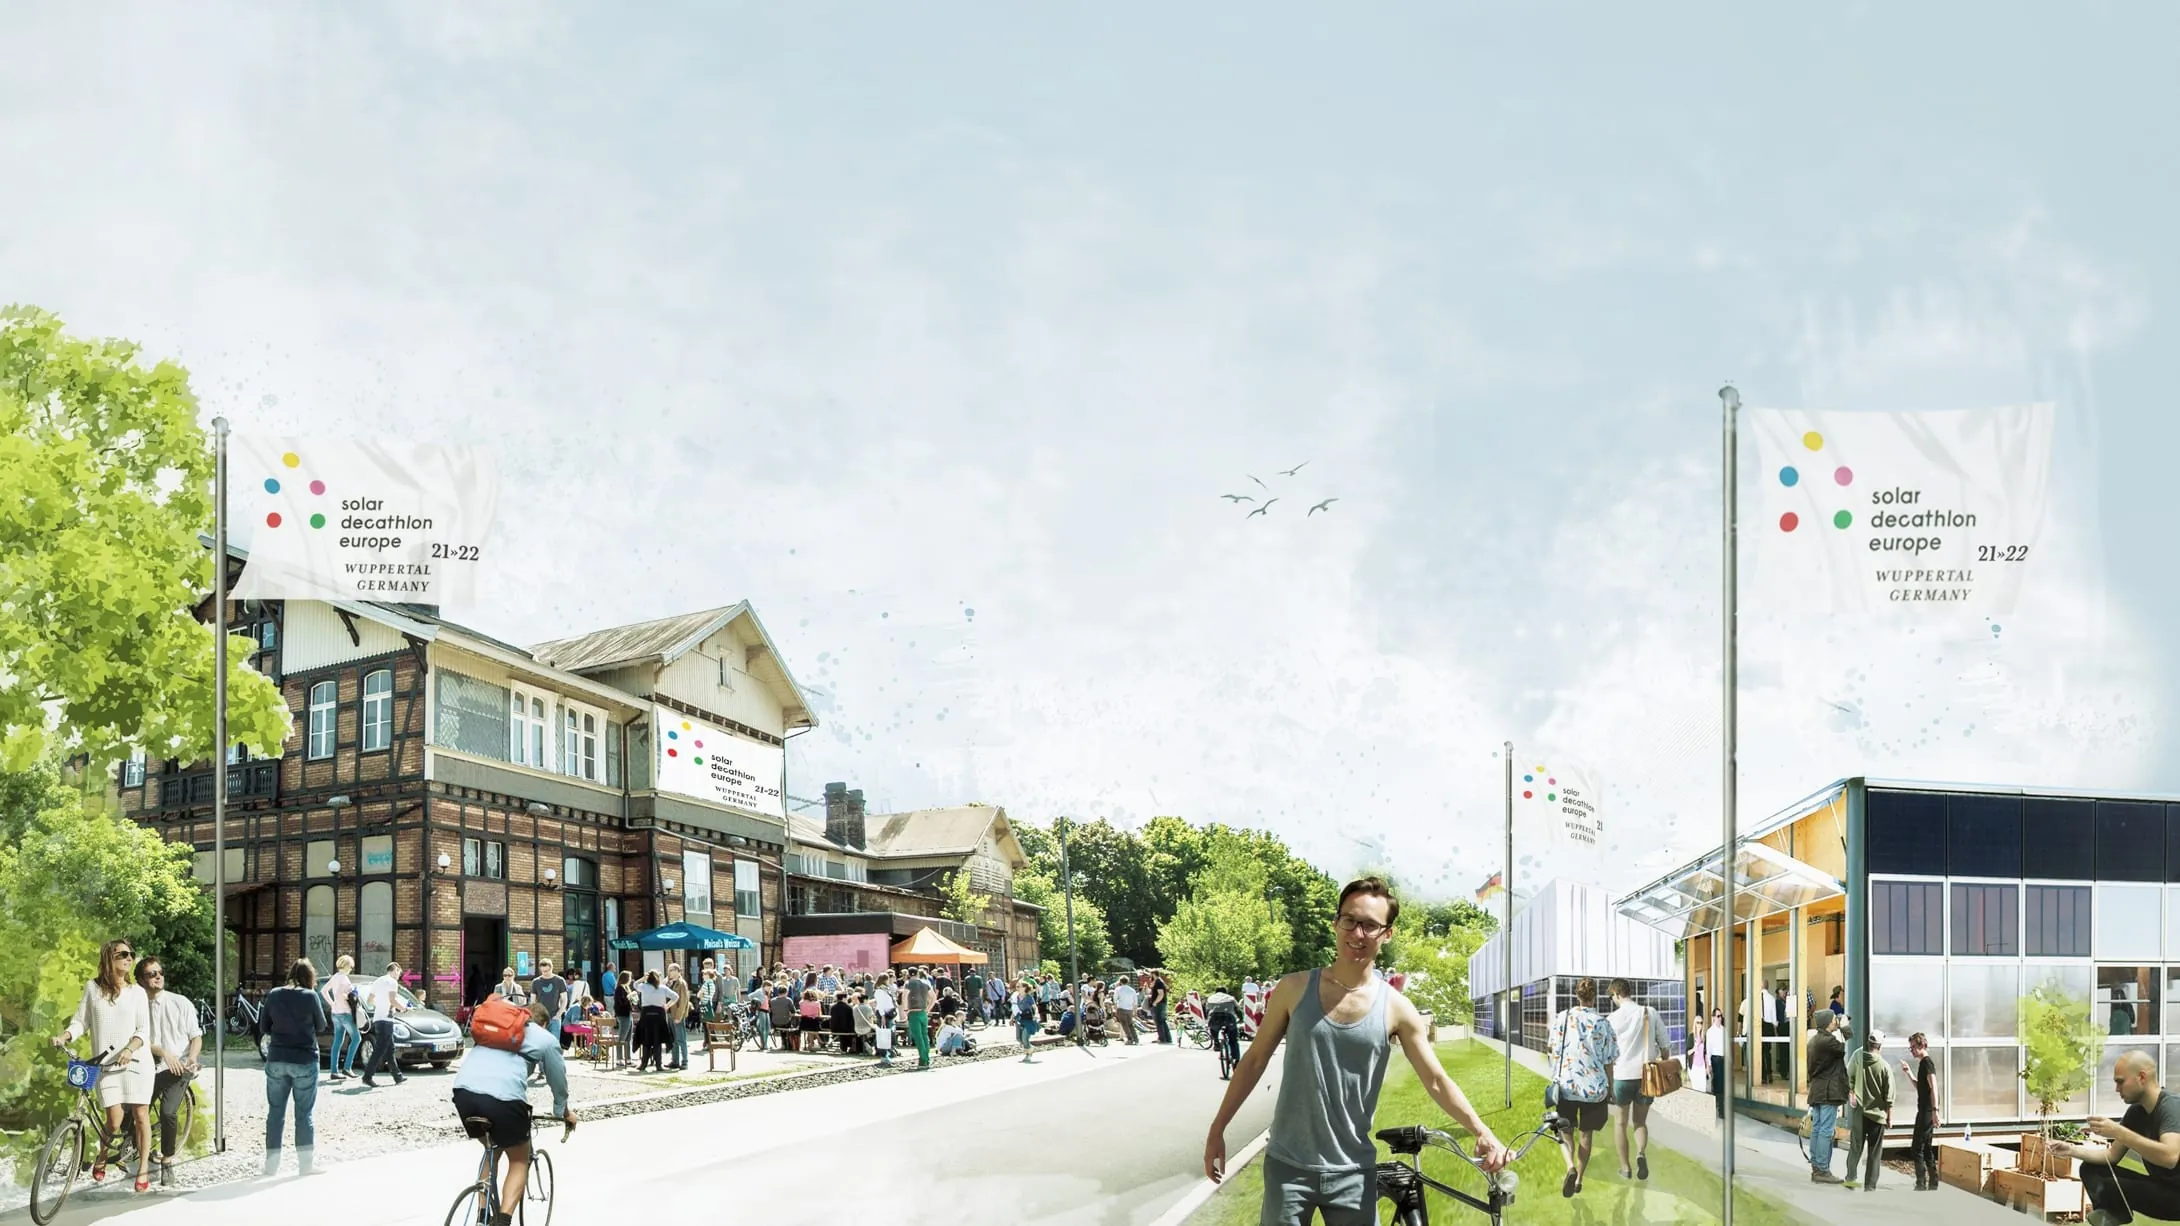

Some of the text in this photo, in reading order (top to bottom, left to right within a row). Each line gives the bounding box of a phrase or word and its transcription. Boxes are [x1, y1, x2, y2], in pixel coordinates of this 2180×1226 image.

[1871, 487, 1921, 504] solar
[341, 497, 384, 511] solar
[341, 515, 433, 530] decathlon
[1871, 510, 1977, 528] decathlon
[339, 535, 402, 552] europe
[1869, 535, 1942, 556] europe
[345, 563, 432, 576] WUPPERTAL
[1875, 570, 1975, 582] WUPPERTAL
[357, 580, 431, 593] GERMANY
[1889, 589, 1972, 602] GERMANY
[711, 754, 733, 766] solar
[710, 772, 743, 786] europe
[711, 762, 756, 782] decathlon
[715, 785, 757, 801] WUPPERTAL
[1562, 788, 1580, 797] solar
[722, 795, 758, 808] GERMANY
[1562, 806, 1587, 819] europe
